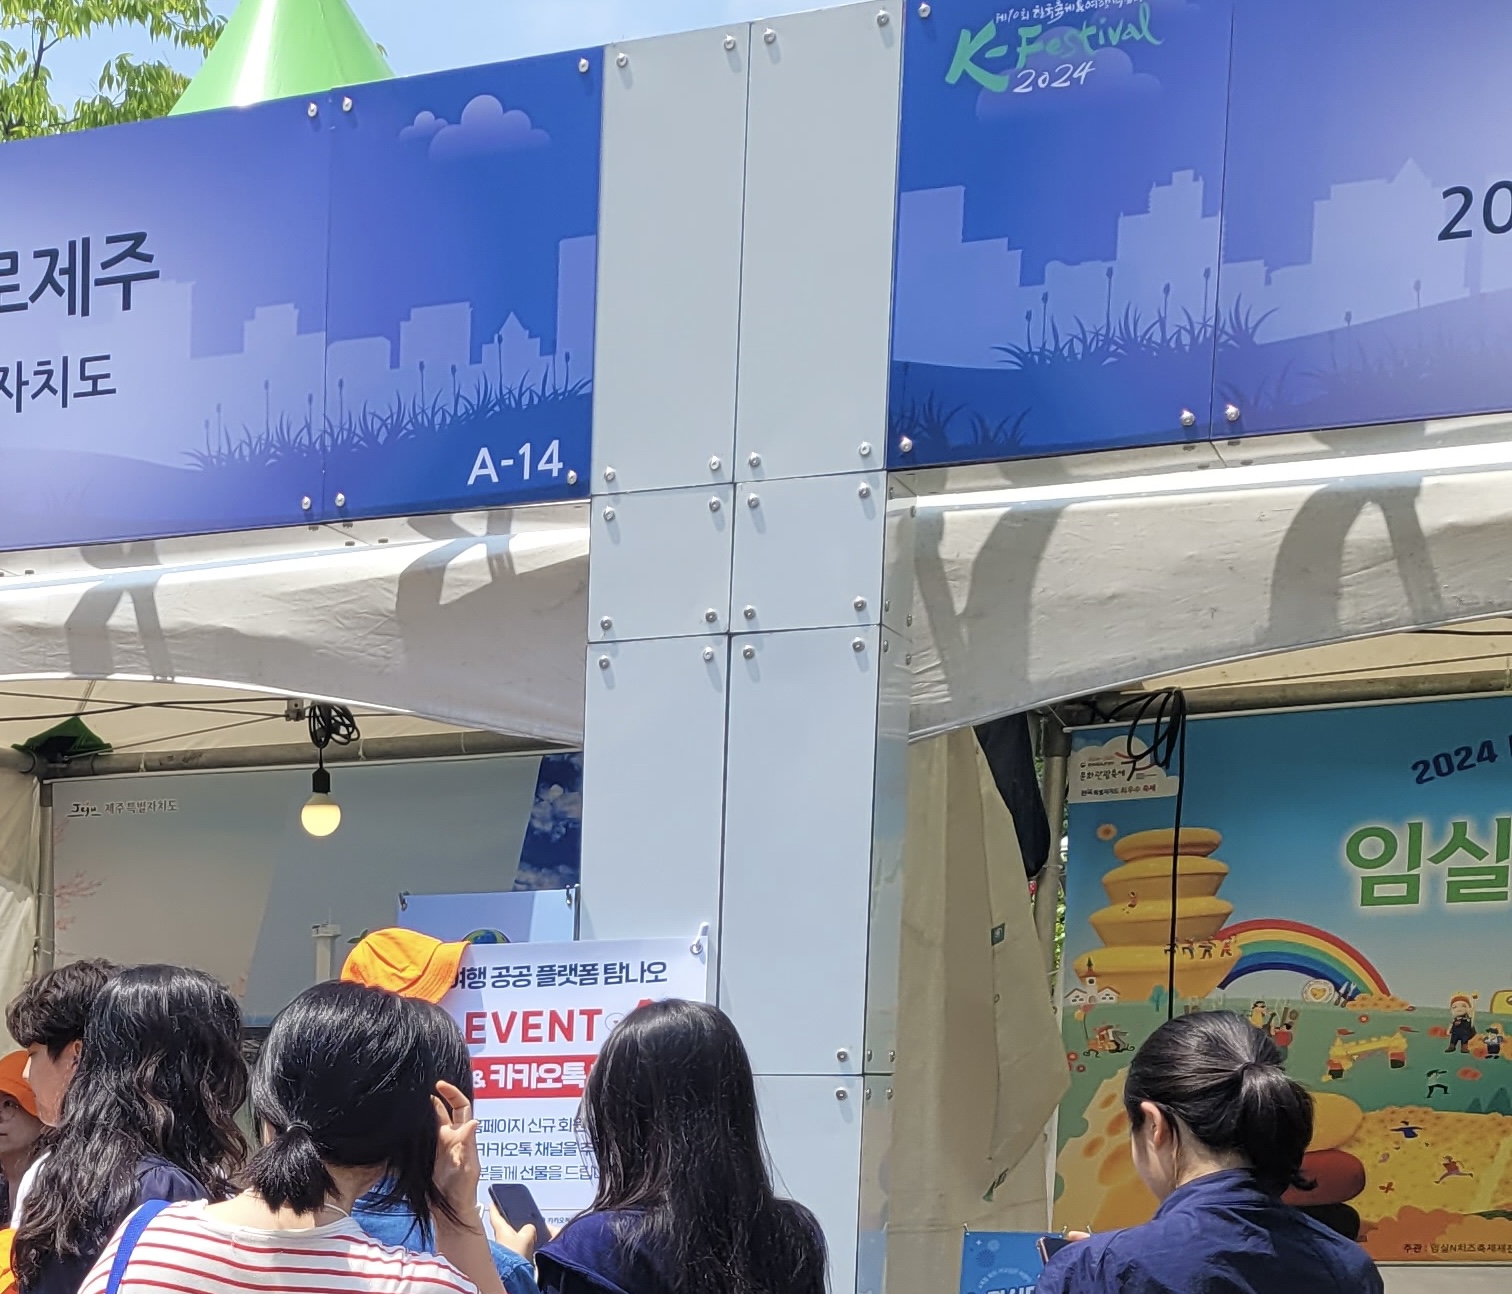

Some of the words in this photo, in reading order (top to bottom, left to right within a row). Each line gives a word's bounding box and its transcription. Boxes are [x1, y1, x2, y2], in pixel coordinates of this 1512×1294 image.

[945, 2, 1165, 93] K-Festival
[1013, 61, 1096, 93] 2024
[467, 439, 564, 486] A-14
[1410, 739, 1499, 785] 2024
[1345, 817, 1512, 907] 임실
[490, 964, 533, 989] 공공
[535, 963, 599, 988] 플랫폼
[603, 960, 669, 986] 탐나오
[465, 1008, 604, 1045] EVENT
[489, 1062, 587, 1090] 카카오톡
[527, 1117, 556, 1133] 신규
[476, 1142, 533, 1157] 카카오톡
[534, 1141, 577, 1157] 채널을
[519, 1165, 563, 1181] 선물을
